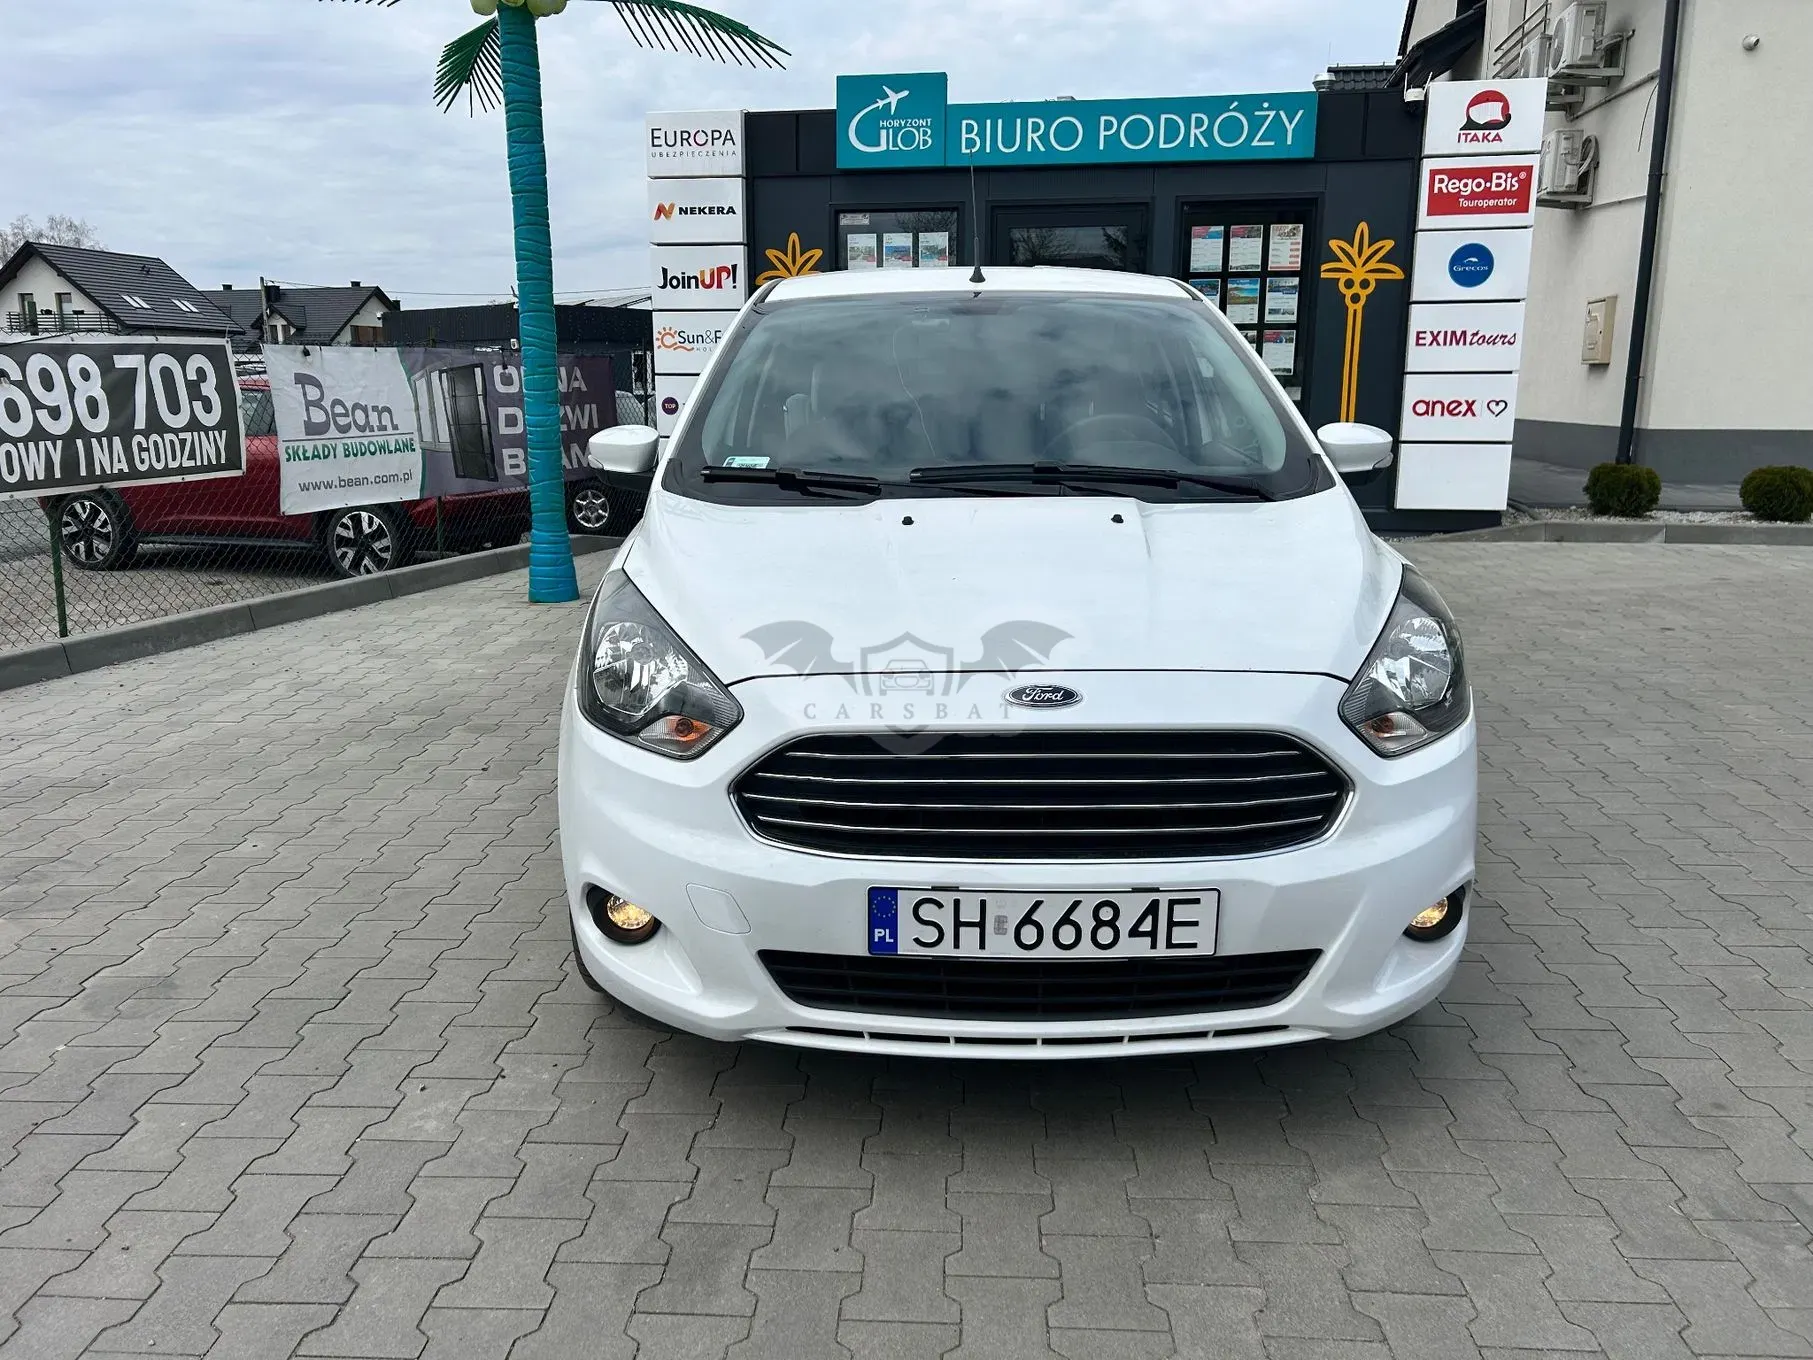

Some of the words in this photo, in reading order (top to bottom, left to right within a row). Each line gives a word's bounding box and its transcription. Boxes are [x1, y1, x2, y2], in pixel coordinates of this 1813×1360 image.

[849, 106, 932, 152] GLOB
[879, 119, 932, 127] HORYZONT
[961, 116, 1084, 153] BIURO
[1099, 101, 1304, 150] PODRÓŻY
[1457, 132, 1502, 143] ITAKA
[679, 206, 736, 215] NEKERA
[1459, 198, 1517, 208] Touroperator
[657, 264, 737, 289] JoinUP!
[678, 330, 722, 344] Sun&F
[0, 353, 110, 438] 698
[113, 353, 222, 430] 703
[294, 372, 399, 436] Bean
[1412, 400, 1477, 417] anex
[76, 438, 87, 477] I
[91, 436, 129, 474] NA
[131, 430, 227, 472] GODZINY
[284, 443, 338, 463] SKŁADY
[343, 438, 416, 459] BUDOWLANE
[298, 469, 413, 492] www.bean.com.pl
[1022, 687, 1065, 701] Ford
[912, 897, 988, 950] SH
[1013, 897, 1202, 951] 6684E
[874, 929, 894, 943] PL
